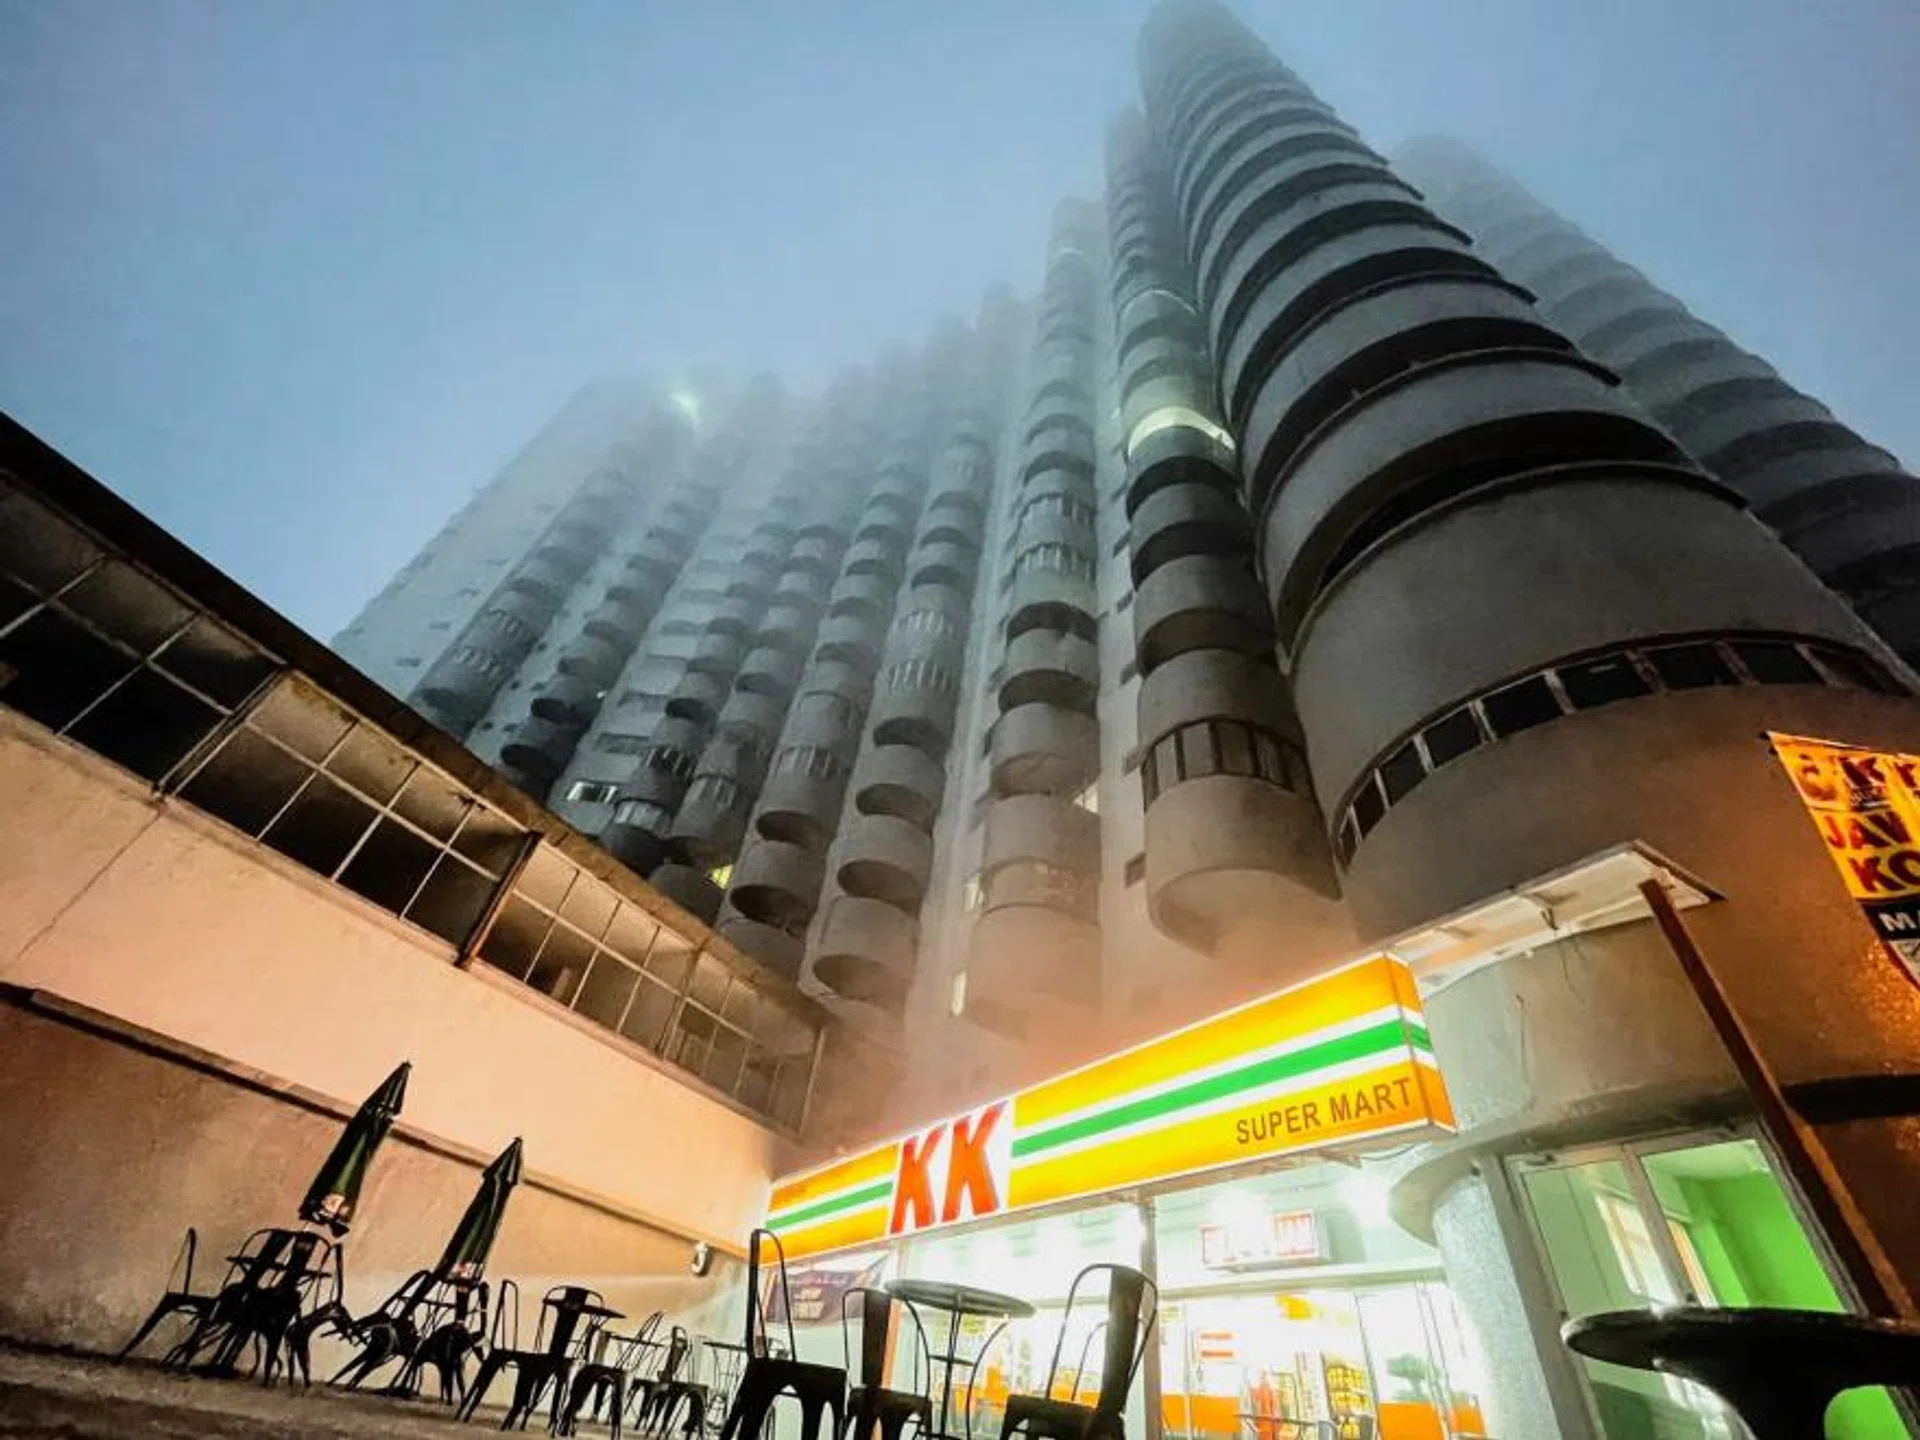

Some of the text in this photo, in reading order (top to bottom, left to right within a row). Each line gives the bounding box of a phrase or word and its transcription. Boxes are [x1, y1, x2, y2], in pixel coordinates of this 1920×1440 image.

[1236, 1077, 1411, 1144] SUPER MART
[890, 1100, 1008, 1234] KK
